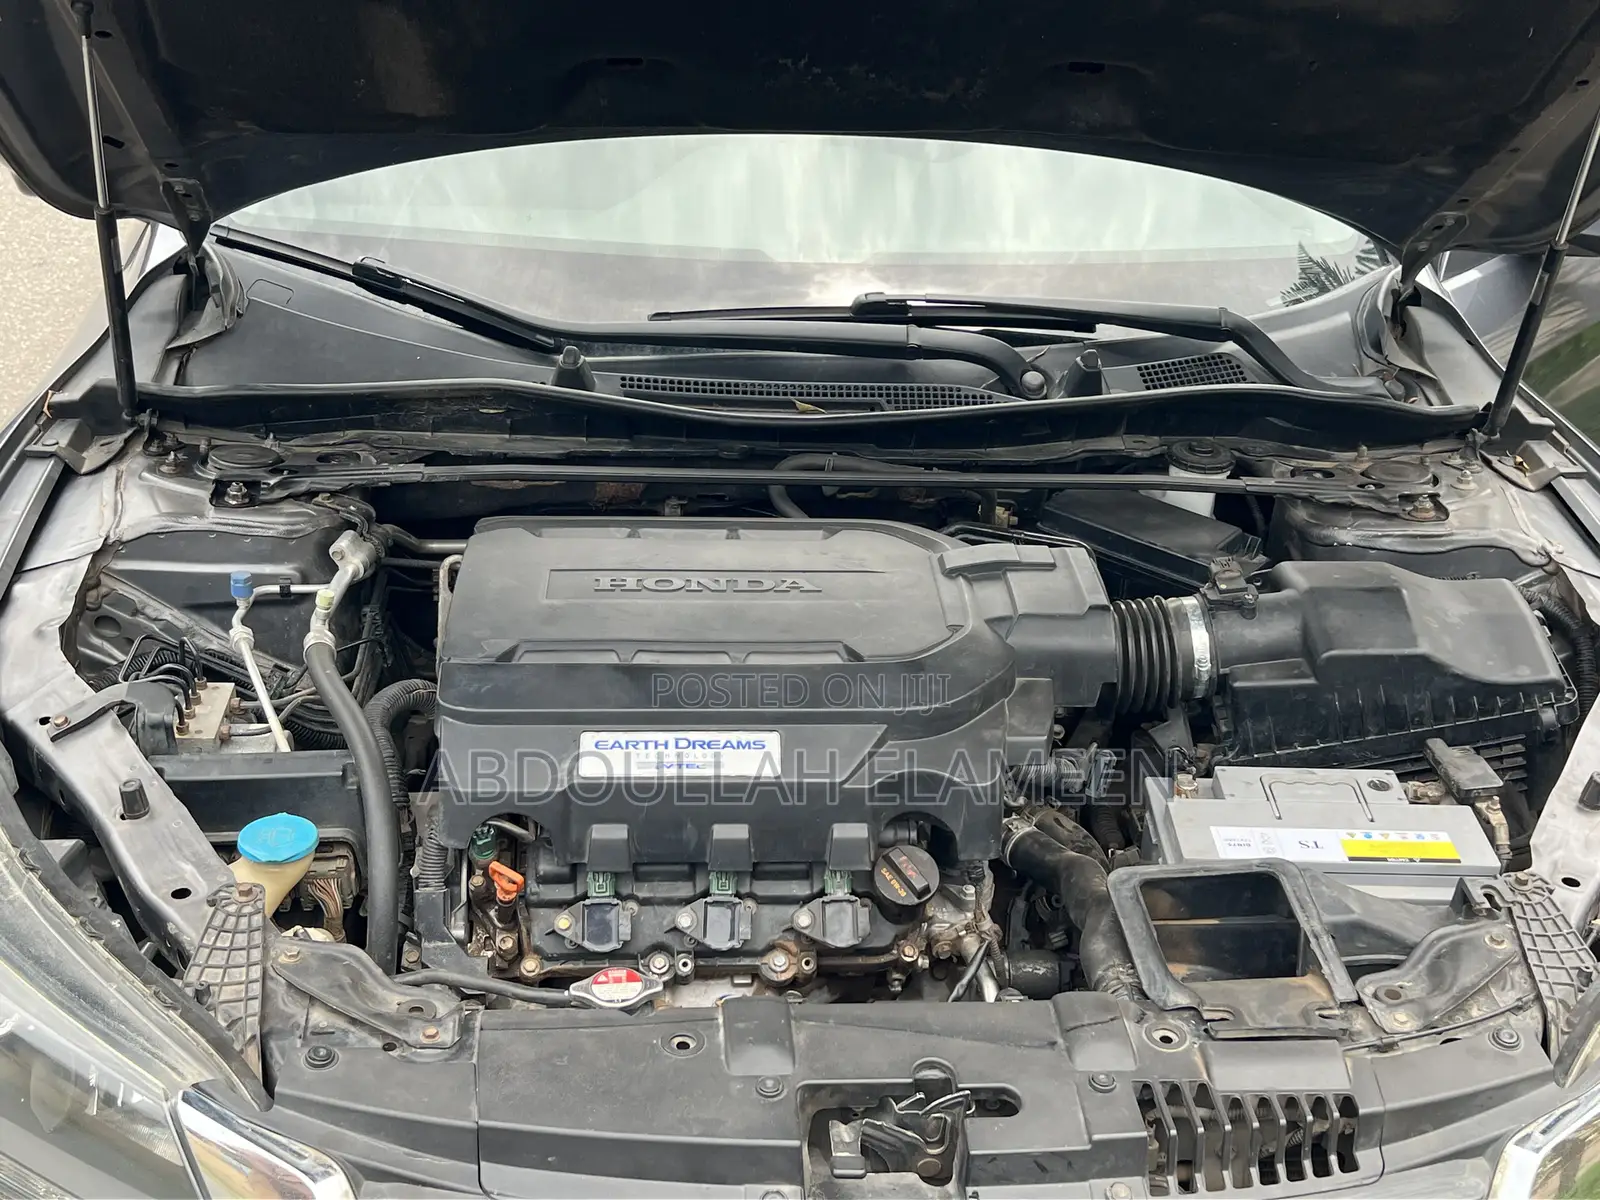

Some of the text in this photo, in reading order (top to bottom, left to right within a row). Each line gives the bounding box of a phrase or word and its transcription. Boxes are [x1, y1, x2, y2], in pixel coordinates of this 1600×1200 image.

[594, 577, 822, 592] HONDA
[594, 740, 669, 750] EARTH
[881, 867, 893, 881] SAE
